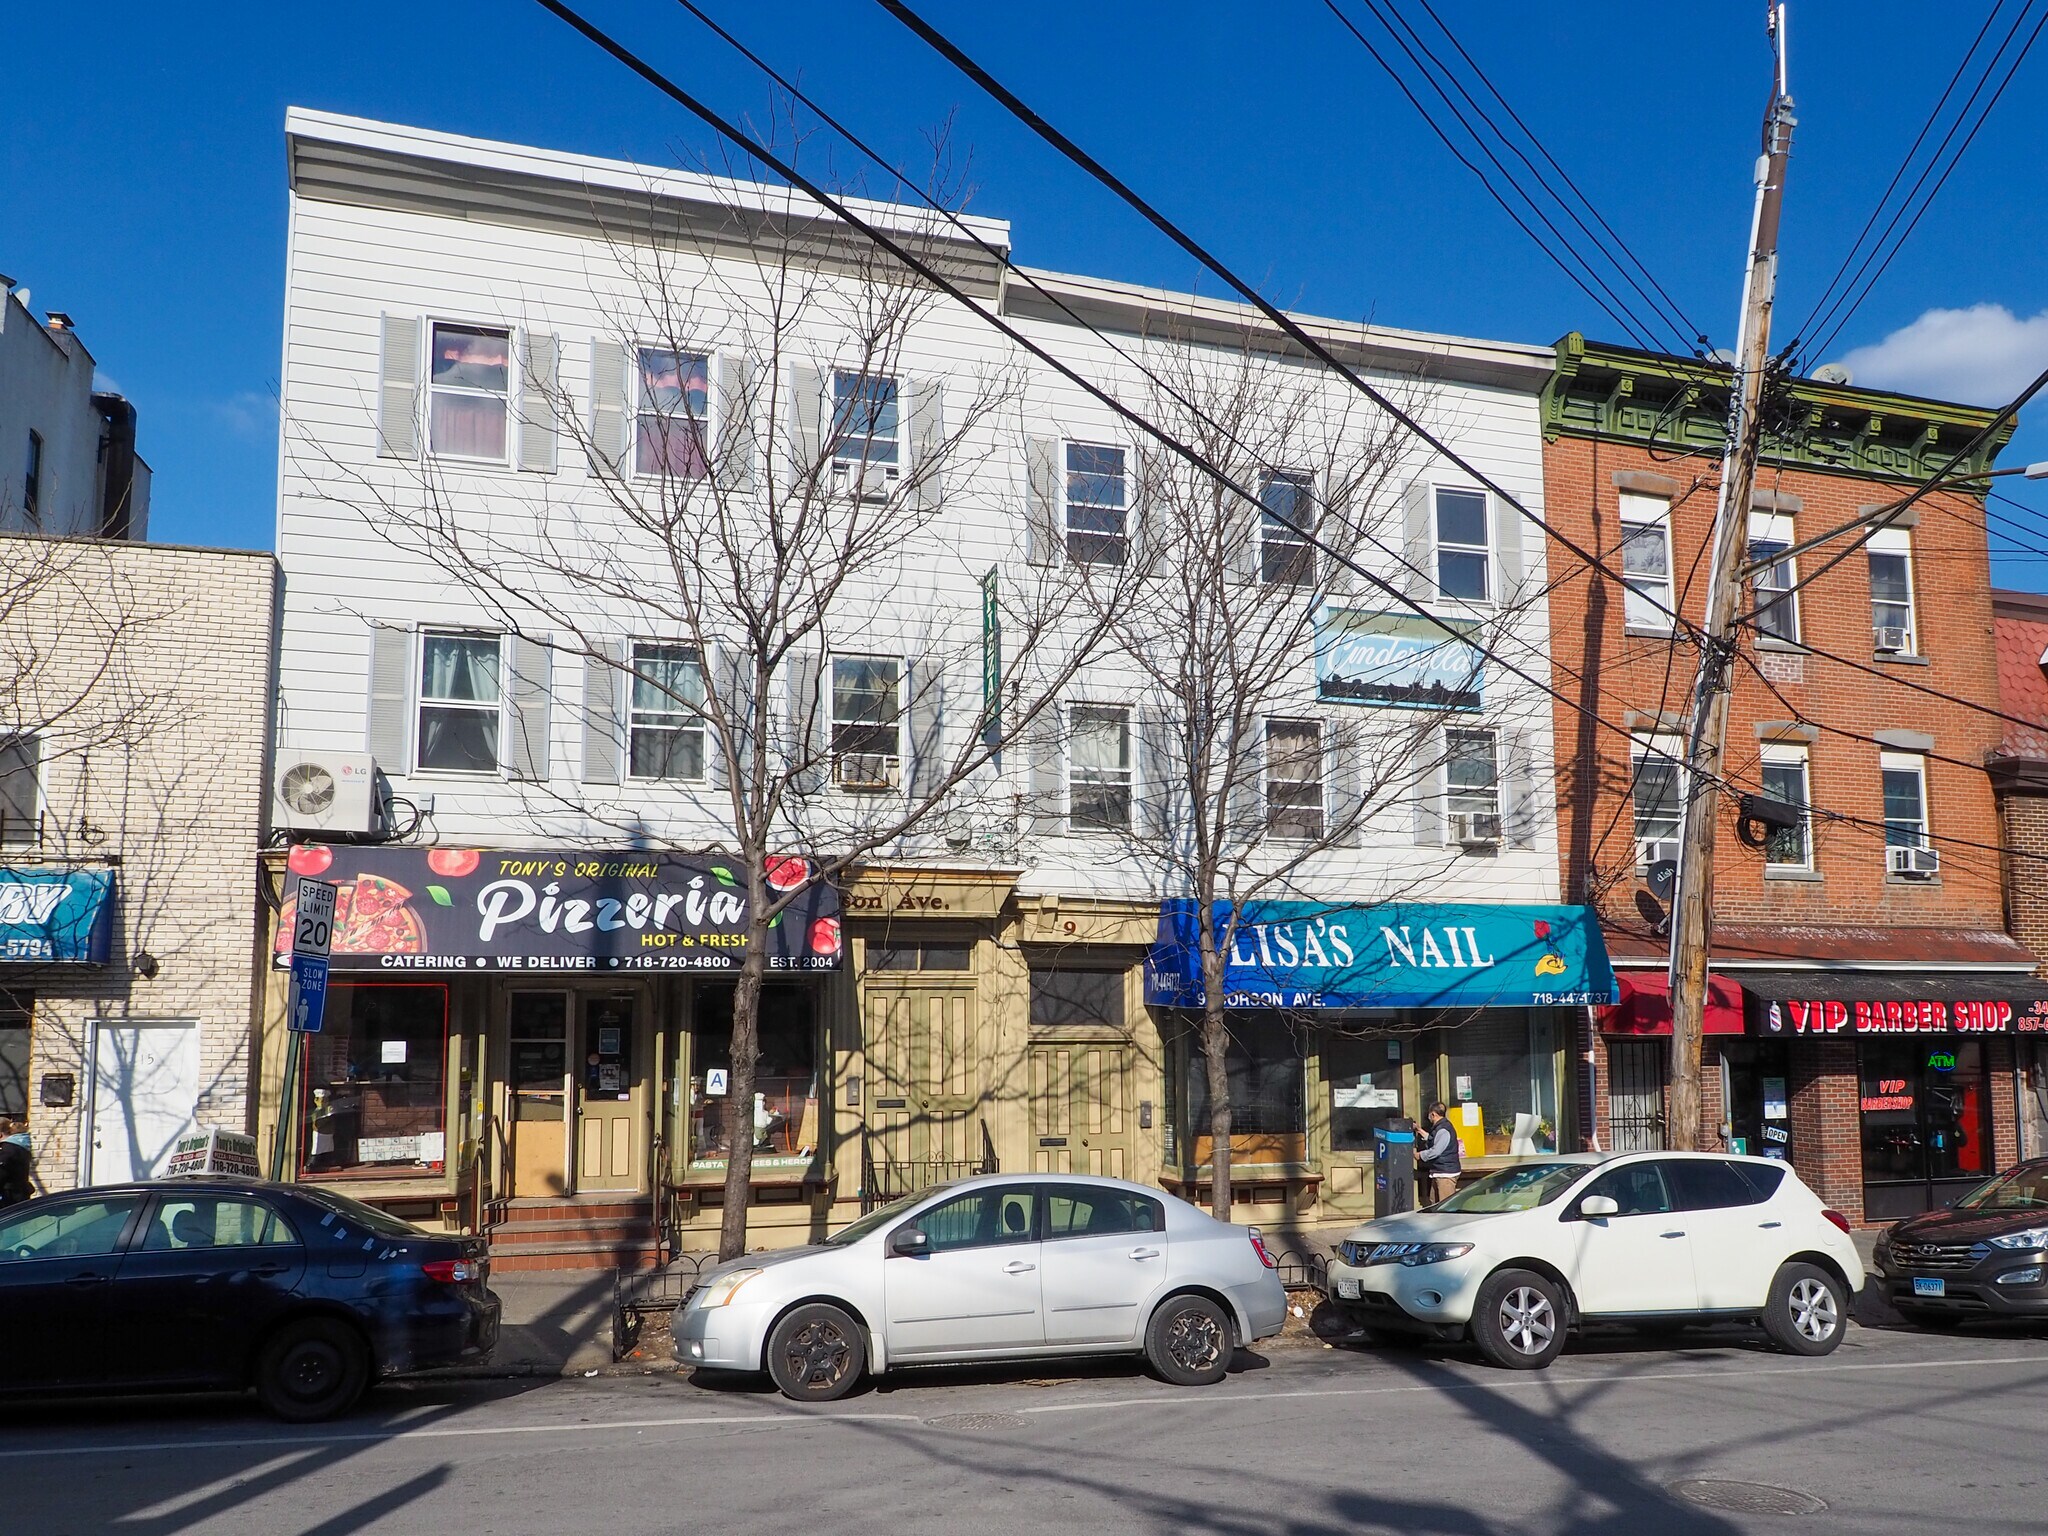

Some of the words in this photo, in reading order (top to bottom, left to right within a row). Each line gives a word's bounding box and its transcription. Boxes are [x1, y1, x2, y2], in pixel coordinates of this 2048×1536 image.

[499, 860, 566, 878] TONY'S
[574, 862, 658, 879] ORIGINAL
[1656, 867, 1675, 882] dish
[302, 885, 333, 902] SPEED
[0, 883, 73, 924] RY
[303, 901, 330, 917] LIMIT
[477, 875, 747, 942] Pizzeria
[897, 894, 950, 910] Ave.
[299, 918, 328, 947] 20
[641, 934, 677, 947] HOT
[682, 934, 694, 947] &
[1223, 918, 1354, 968] LISA'S
[1380, 926, 1495, 968] NAIL
[381, 955, 466, 968] CATERING
[497, 956, 525, 968] WE
[528, 956, 597, 969] DELIVER
[625, 956, 731, 969] 718-720-4800
[770, 957, 798, 969] EST.
[803, 957, 834, 969] 2004
[303, 967, 324, 980] SLOW
[301, 979, 322, 991] ZONE
[1224, 993, 1283, 1007] ORSON
[1293, 993, 1326, 1007] AVE.
[1532, 992, 1609, 1004] 718-447-1737
[1788, 1001, 1848, 1033] VIP
[1855, 1001, 1948, 1032] BARBER
[1954, 1001, 2012, 1032] SHOP
[1928, 1055, 1955, 1067] ATM
[710, 1073, 723, 1087] A
[1880, 1080, 1906, 1094] VIP
[1861, 1096, 1913, 1110] BARBERSHOP
[1768, 1129, 1787, 1141] OPEN
[212, 1160, 259, 1177] 718-720-4800
[692, 1161, 724, 1169] PASTA
